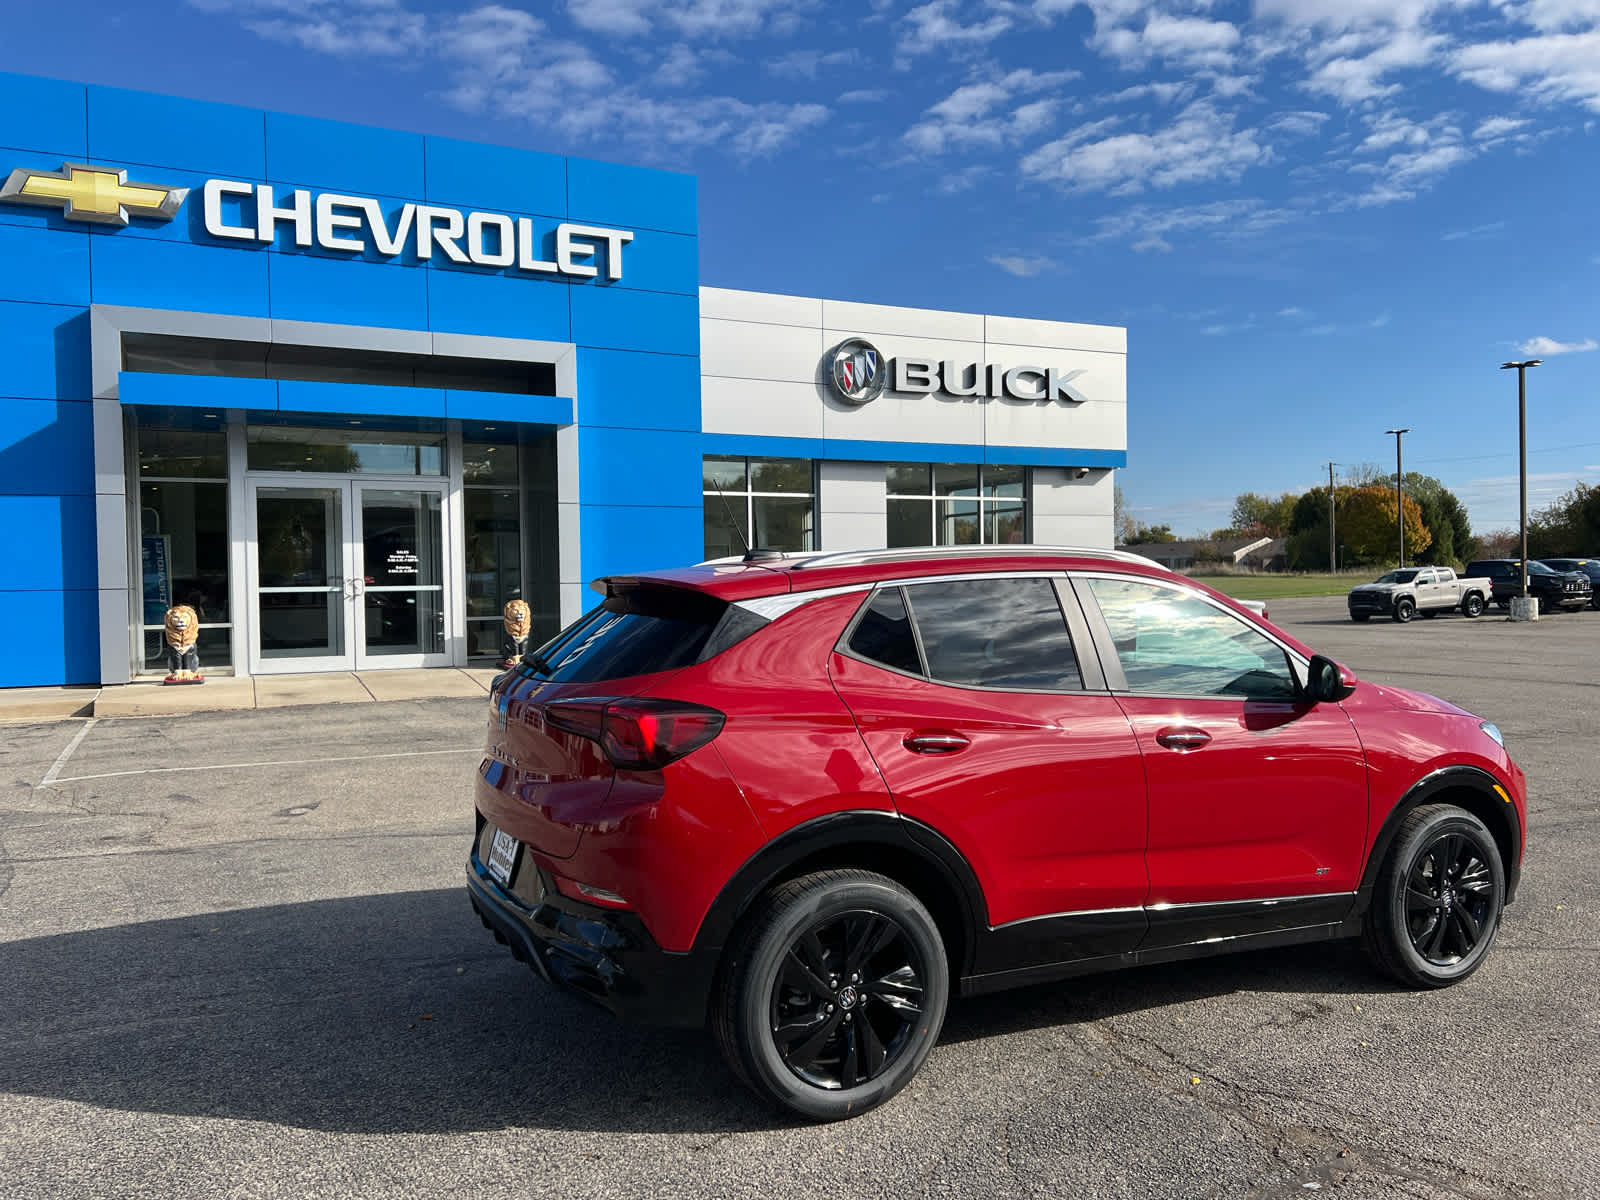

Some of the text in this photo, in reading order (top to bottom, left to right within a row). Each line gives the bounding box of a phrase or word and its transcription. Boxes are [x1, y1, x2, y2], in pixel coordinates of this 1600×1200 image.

[204, 179, 634, 280] CHEVROLET
[895, 357, 1088, 404] BUICK
[155, 542, 167, 603] CHEVROLET
